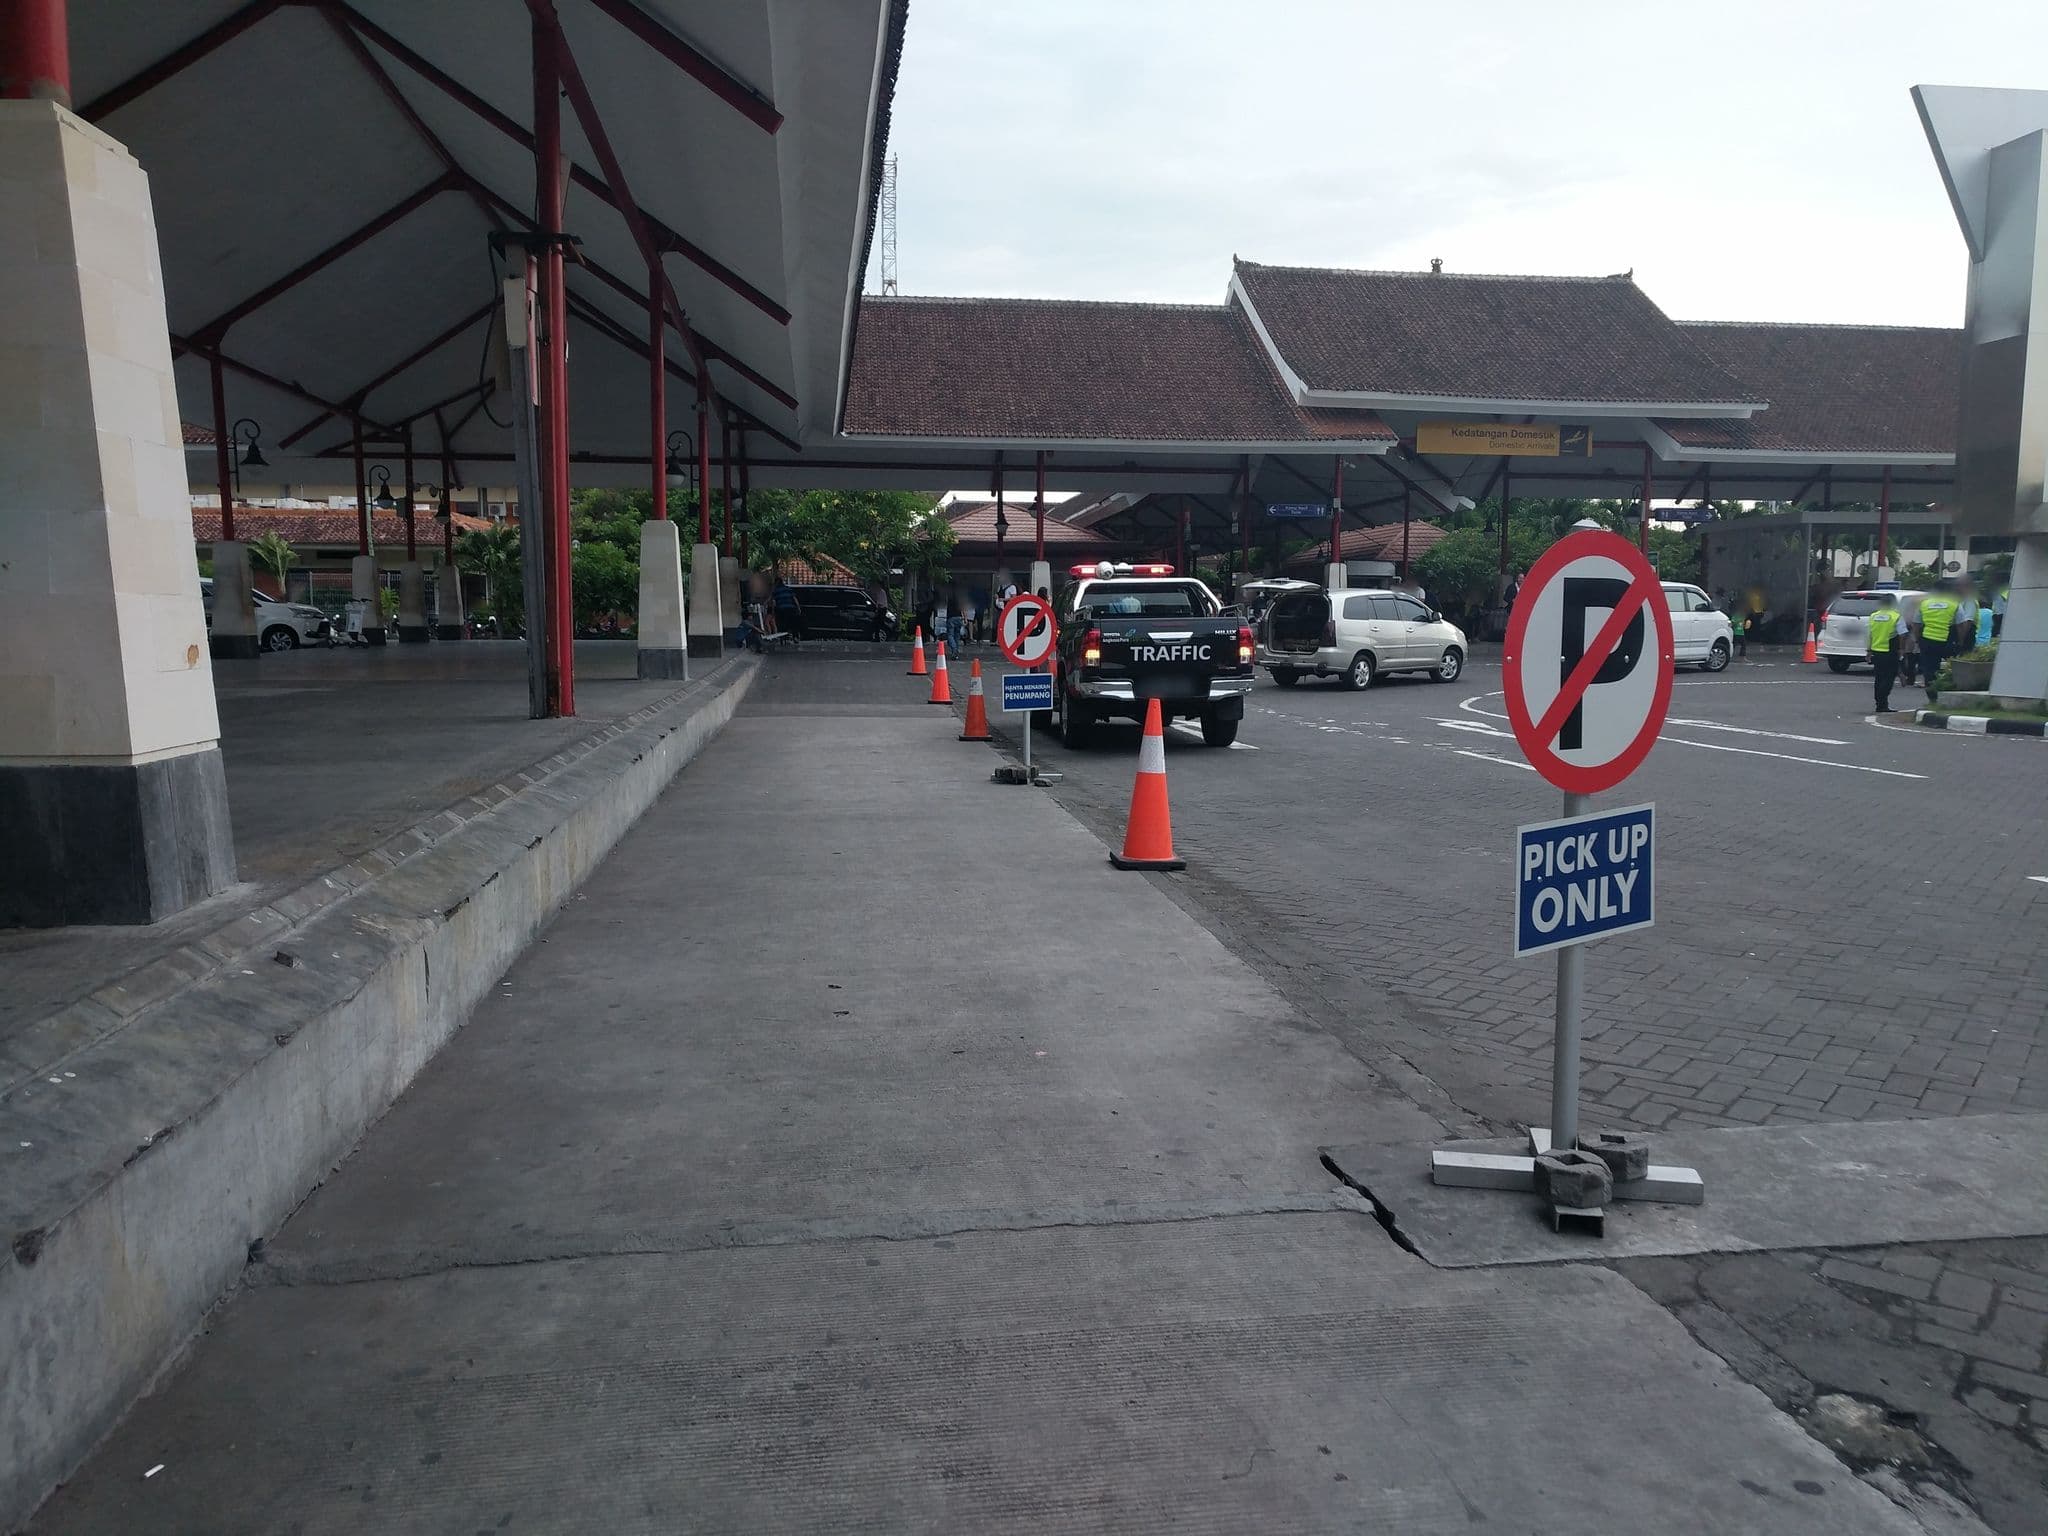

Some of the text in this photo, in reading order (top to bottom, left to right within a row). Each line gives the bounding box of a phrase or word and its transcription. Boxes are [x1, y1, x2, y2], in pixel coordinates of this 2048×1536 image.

[1451, 428, 1508, 440] Kedatangan
[1489, 440, 1525, 449] Domestic
[1016, 607, 1046, 655] P
[1130, 644, 1212, 662] TRAFFIC
[1559, 577, 1645, 750] P
[1004, 690, 1051, 700] PENUMPANG
[1524, 823, 1649, 882] PICK UP
[1531, 869, 1640, 933] ONLY
